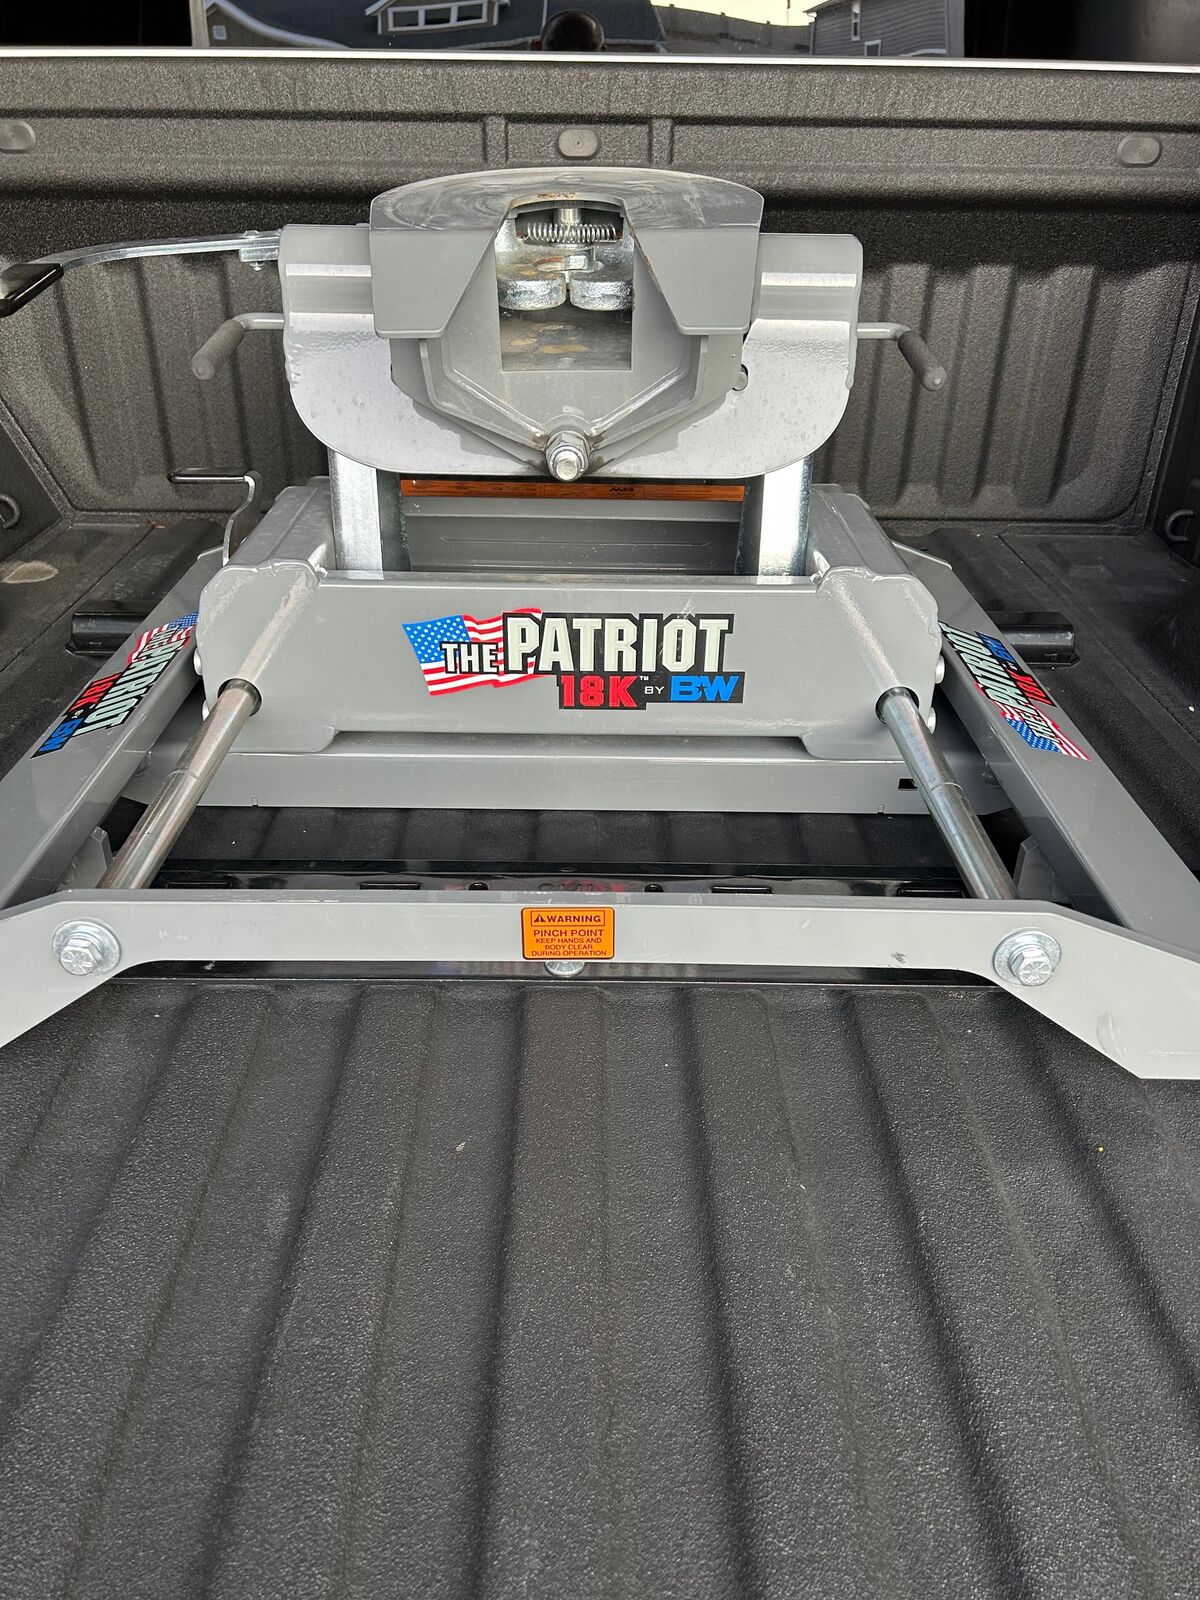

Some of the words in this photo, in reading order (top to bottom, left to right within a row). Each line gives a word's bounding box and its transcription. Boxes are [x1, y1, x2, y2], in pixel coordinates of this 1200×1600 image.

[442, 643, 498, 673] THE
[506, 617, 730, 672] PATRIOT
[71, 638, 187, 737] PATRIOT
[938, 622, 1039, 716] PATRIOT
[1006, 669, 1053, 704] 18K
[67, 673, 124, 713] 18K
[644, 686, 665, 695] BY
[533, 929, 567, 937] PINCH
[571, 929, 604, 937] POINT
[547, 915, 601, 923] WARNING
